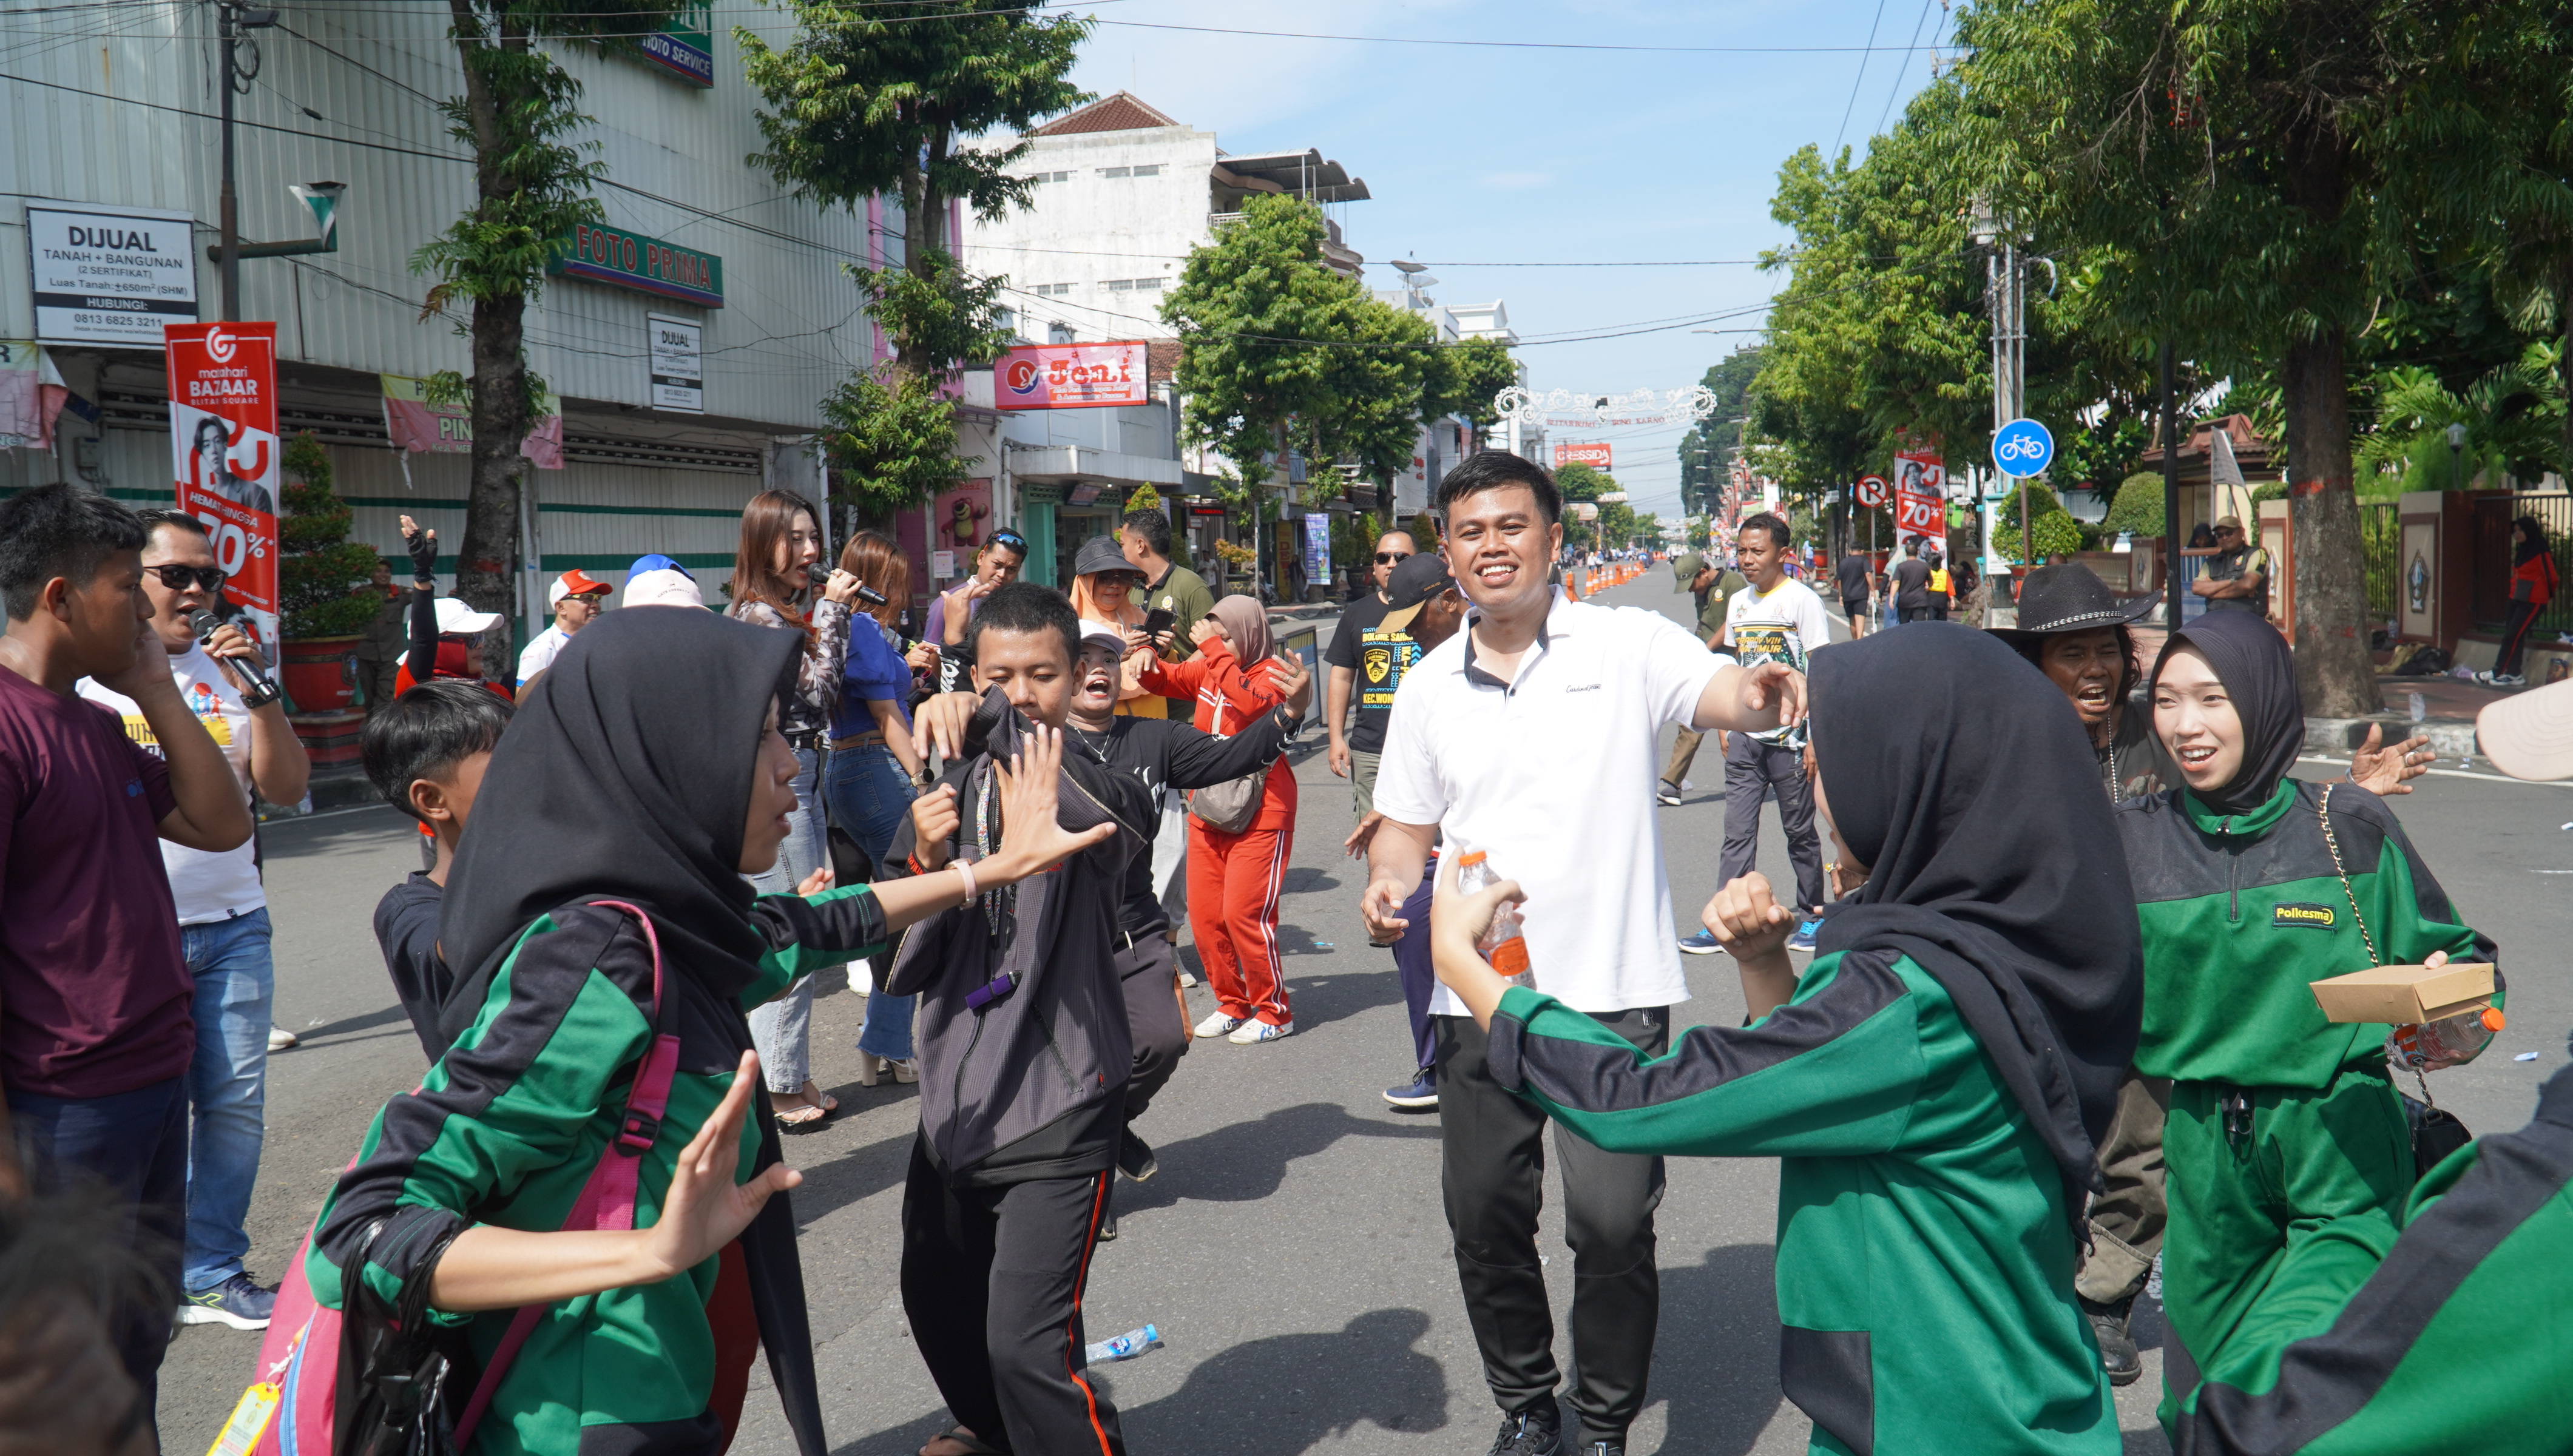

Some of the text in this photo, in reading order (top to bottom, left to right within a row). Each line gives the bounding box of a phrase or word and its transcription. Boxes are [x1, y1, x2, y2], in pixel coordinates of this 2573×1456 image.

[672, 45, 711, 76] SERVICE
[69, 226, 157, 252] DIJUAL
[43, 249, 91, 262] TANAH
[106, 254, 183, 268] BANGUNAN
[576, 223, 712, 291] FOTO PRIMA
[49, 277, 75, 288] Luas
[158, 286, 187, 297] (SHM)
[86, 297, 149, 311] HUBUNGI:
[74, 314, 163, 327] 0813 6825 3211
[661, 329, 690, 348] DIJUAL
[1049, 357, 1131, 385] Jeni
[189, 379, 258, 397] BAZAAR
[222, 397, 259, 405] SQUARE
[1635, 416, 1666, 425] KARNO
[1557, 448, 1610, 461] CRESSIDA
[1867, 480, 1881, 501] P
[190, 491, 259, 528] HEMAT HINGGA
[2276, 908, 2330, 921] Polkesma
